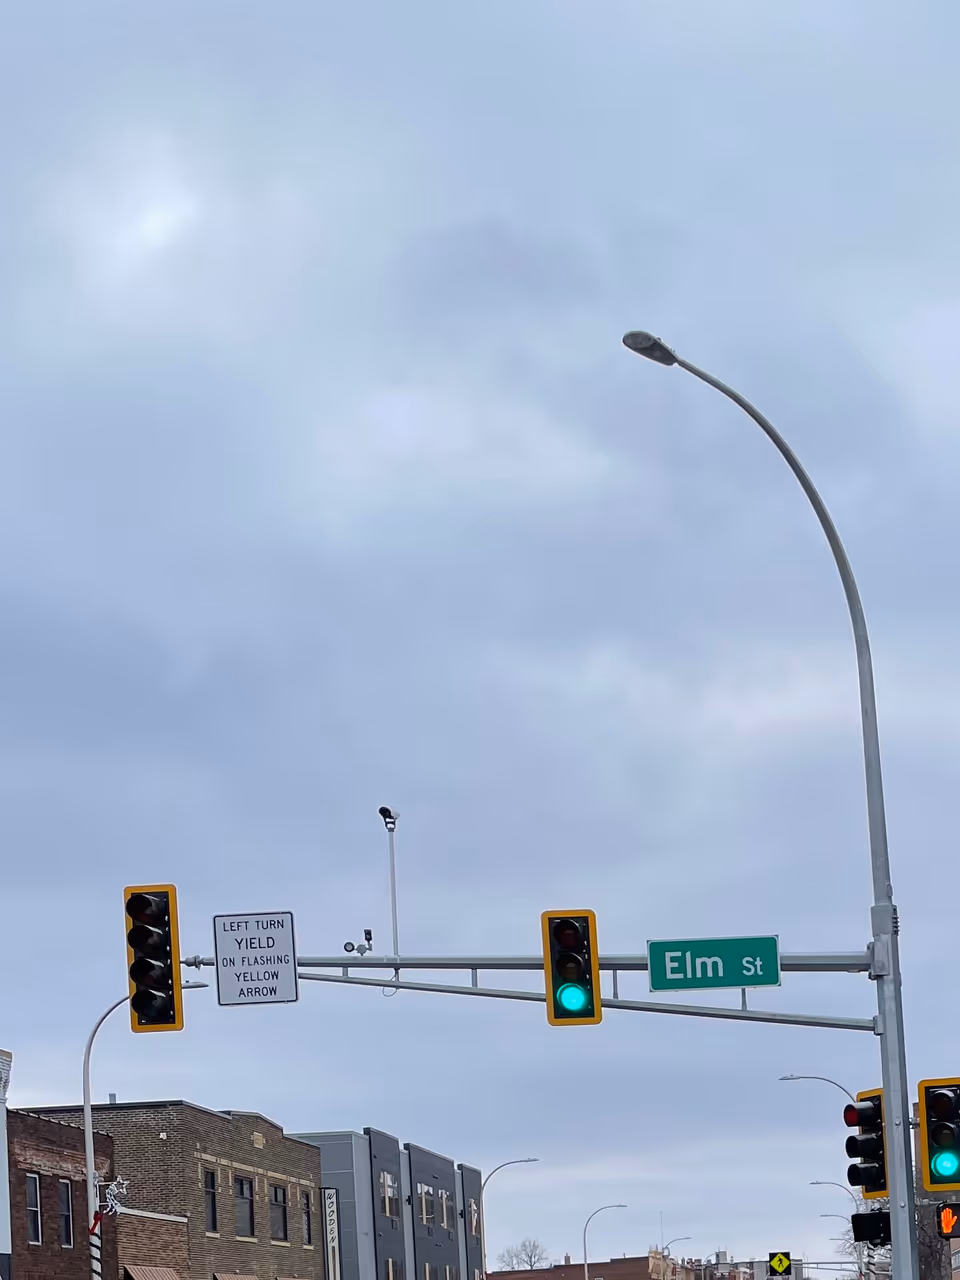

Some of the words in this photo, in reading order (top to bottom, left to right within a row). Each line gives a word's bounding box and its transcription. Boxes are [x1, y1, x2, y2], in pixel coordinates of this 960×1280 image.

[223, 921, 249, 932] LEFT
[255, 919, 285, 931] TURN
[234, 936, 275, 950] YIELD
[222, 957, 235, 968] ON
[241, 954, 290, 967] FLASHING
[665, 951, 724, 979] Elm
[742, 956, 763, 976] St
[234, 970, 279, 982] YELLOW
[238, 986, 277, 998] ARROW
[326, 1192, 337, 1244] WOODEN
